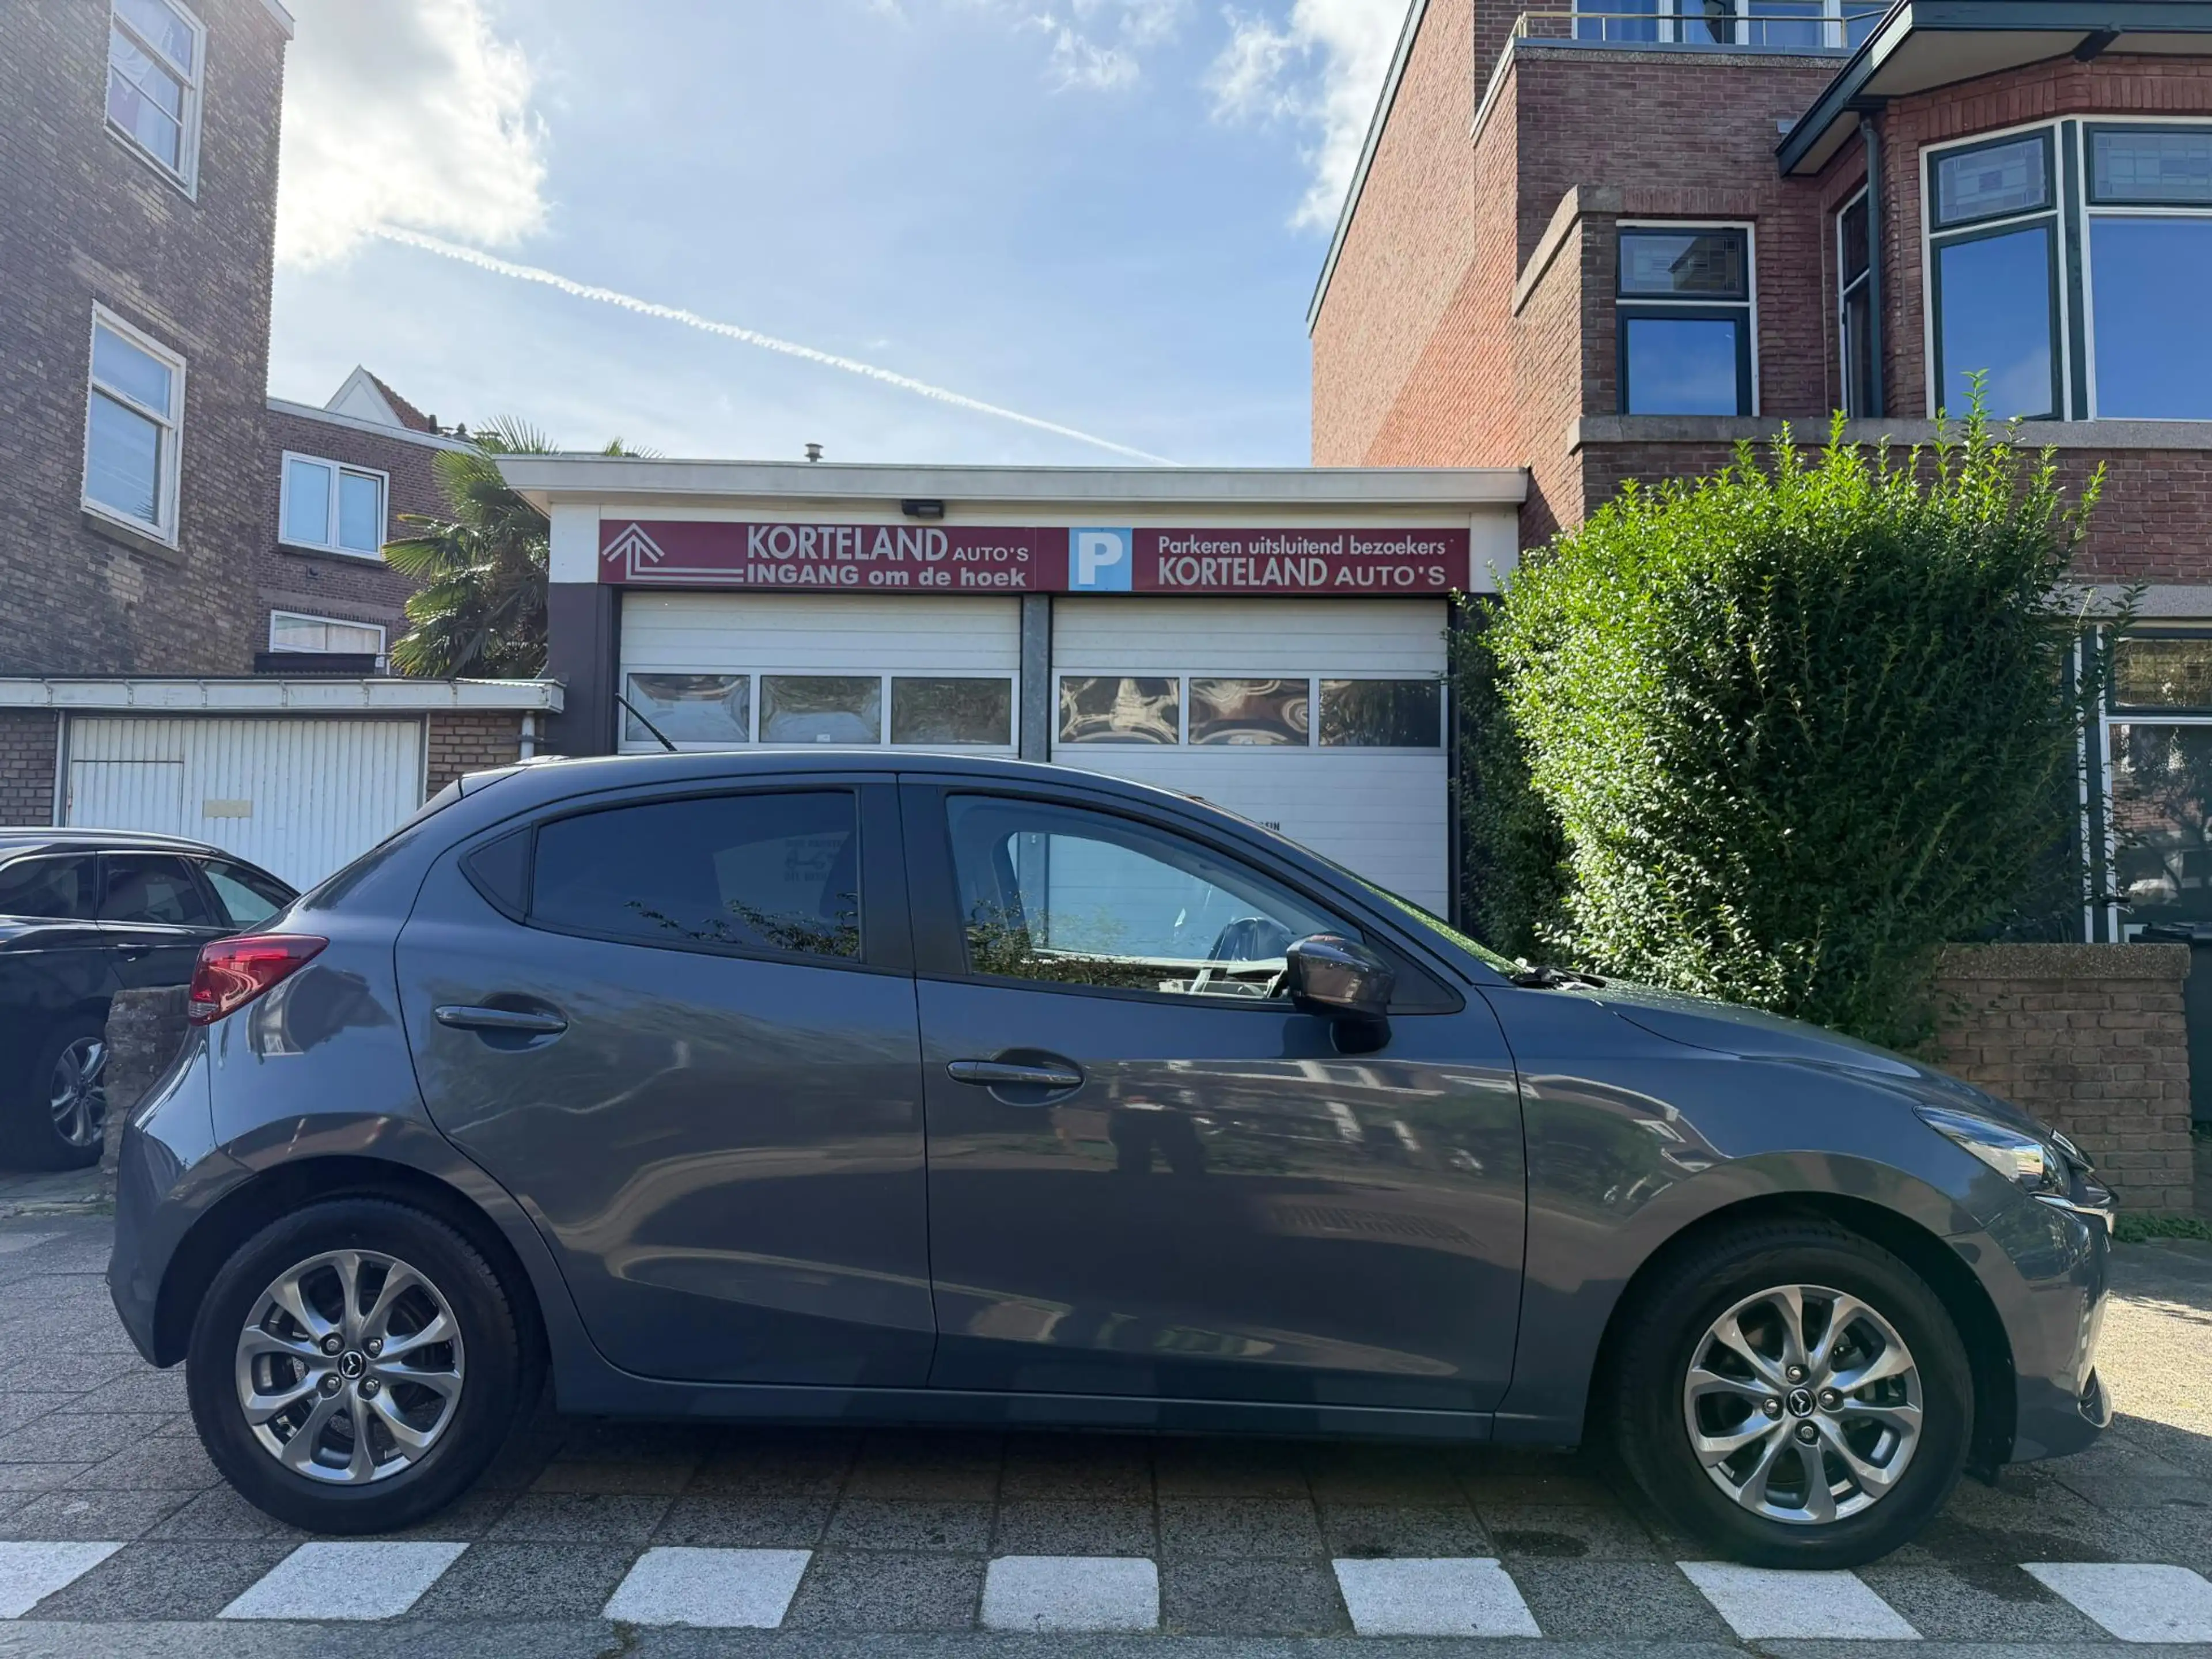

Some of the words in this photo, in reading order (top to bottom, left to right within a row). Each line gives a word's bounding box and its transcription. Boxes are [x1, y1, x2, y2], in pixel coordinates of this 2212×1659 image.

[748, 525, 948, 561] KORTELAND
[952, 547, 1029, 562] AUTO'S
[1078, 532, 1123, 585] P
[1158, 535, 1242, 555] Parkeren
[1249, 535, 1343, 555] uitsluitend
[1350, 535, 1445, 555] bezoekers
[747, 563, 859, 585] INGANG
[868, 570, 909, 585] om
[919, 566, 951, 586] de
[960, 567, 1027, 586] hoek
[1158, 556, 1328, 586] KORTELAND
[1334, 565, 1446, 586] AUTO'S
